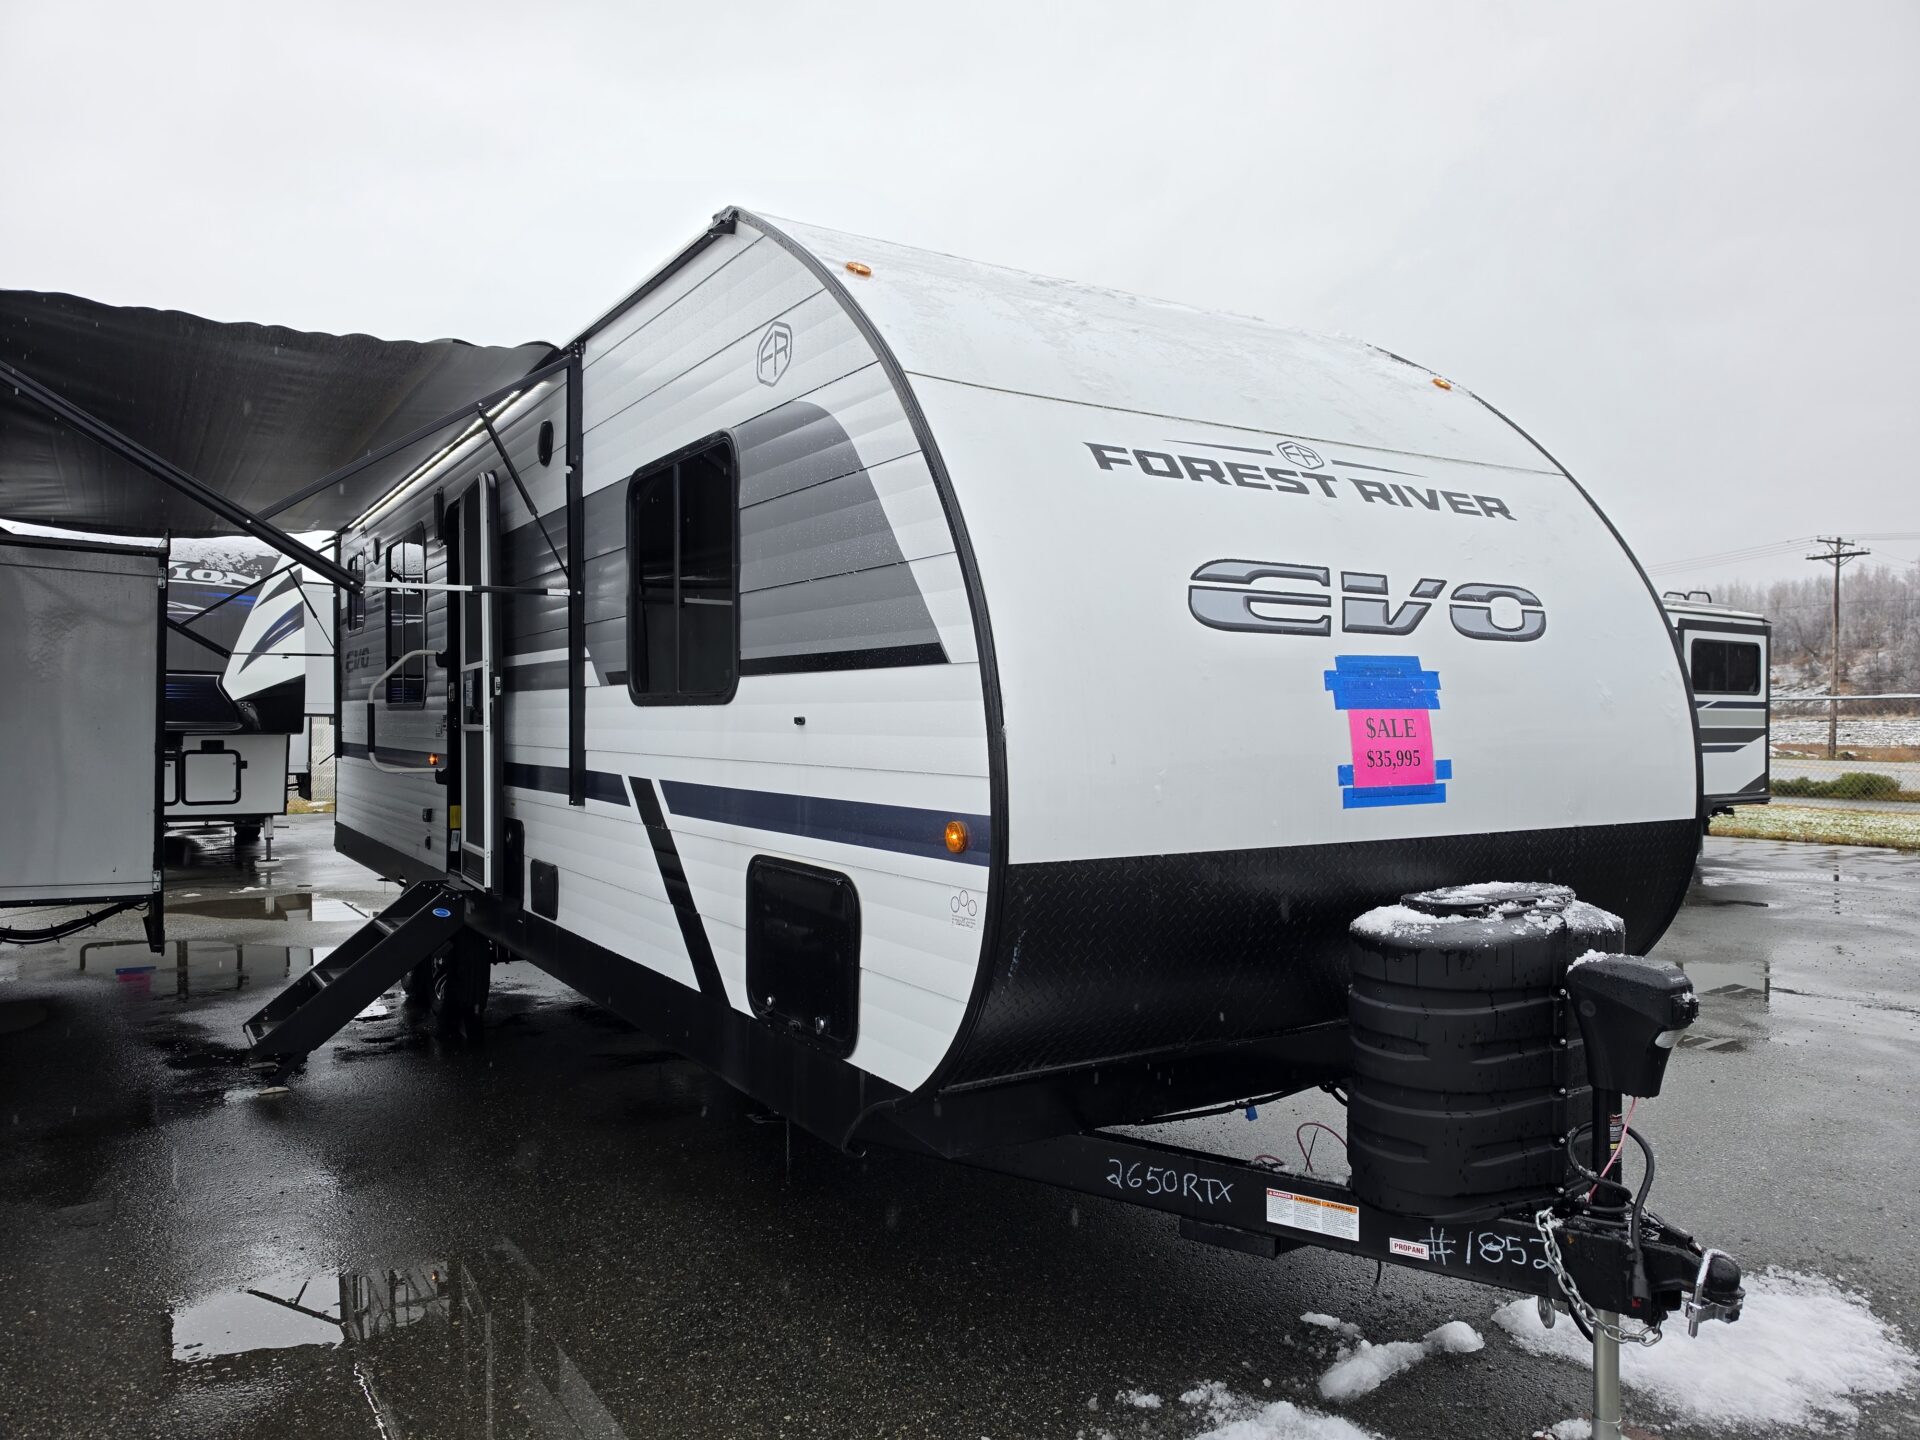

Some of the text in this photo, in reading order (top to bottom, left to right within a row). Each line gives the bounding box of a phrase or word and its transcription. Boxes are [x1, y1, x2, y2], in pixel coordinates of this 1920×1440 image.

[1082, 441, 1517, 521] FOREST RIVER
[1188, 558, 1547, 642] EVO
[1366, 749, 1421, 769] $35,995
[1106, 1159, 1234, 1205] 2650RTX
[1394, 1242, 1425, 1255] PROPANE
